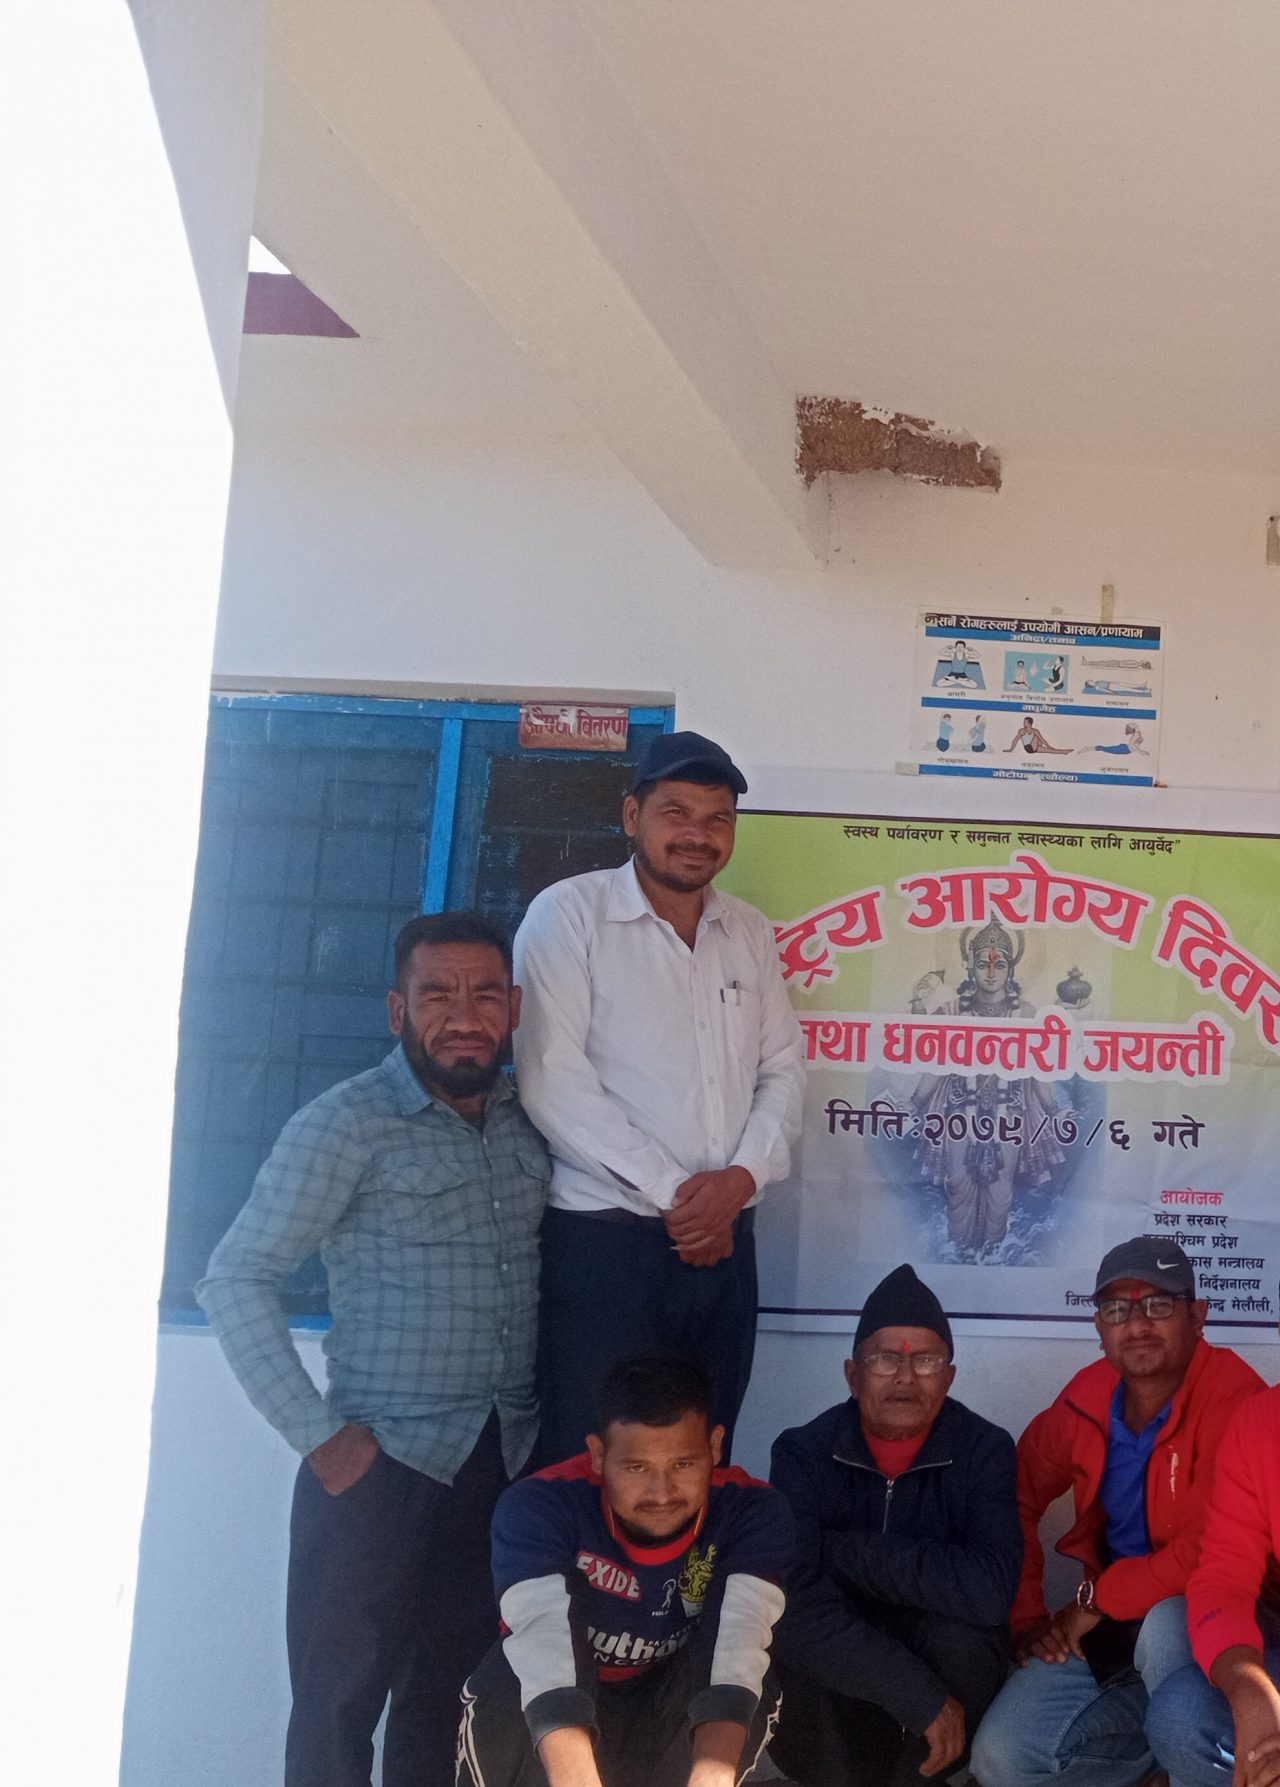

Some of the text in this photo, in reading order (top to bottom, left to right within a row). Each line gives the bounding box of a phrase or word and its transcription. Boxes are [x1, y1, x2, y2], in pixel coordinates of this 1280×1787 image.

[1020, 620, 1060, 634] उपयोगी
[843, 825, 880, 839] स्वस्थ
[886, 825, 944, 842] पर्यावरण
[949, 830, 960, 844] र
[966, 830, 1011, 847] समुन्नत
[1090, 833, 1123, 850] लागि
[901, 856, 1148, 943] आरोग्य
[883, 1014, 1071, 1072] धनवन्तरी
[1083, 1020, 1225, 1077] जयन्ती
[1152, 1114, 1206, 1149] गते
[1160, 1188, 1223, 1206] आयोजक
[1154, 1211, 1228, 1229] प्रदेश सरकार
[1211, 1233, 1239, 1249] प्रदेश
[1218, 1257, 1265, 1270] मन्त्रालय
[1199, 1273, 1261, 1291] निर्देशनालय
[576, 1554, 641, 1599] EXIDE
